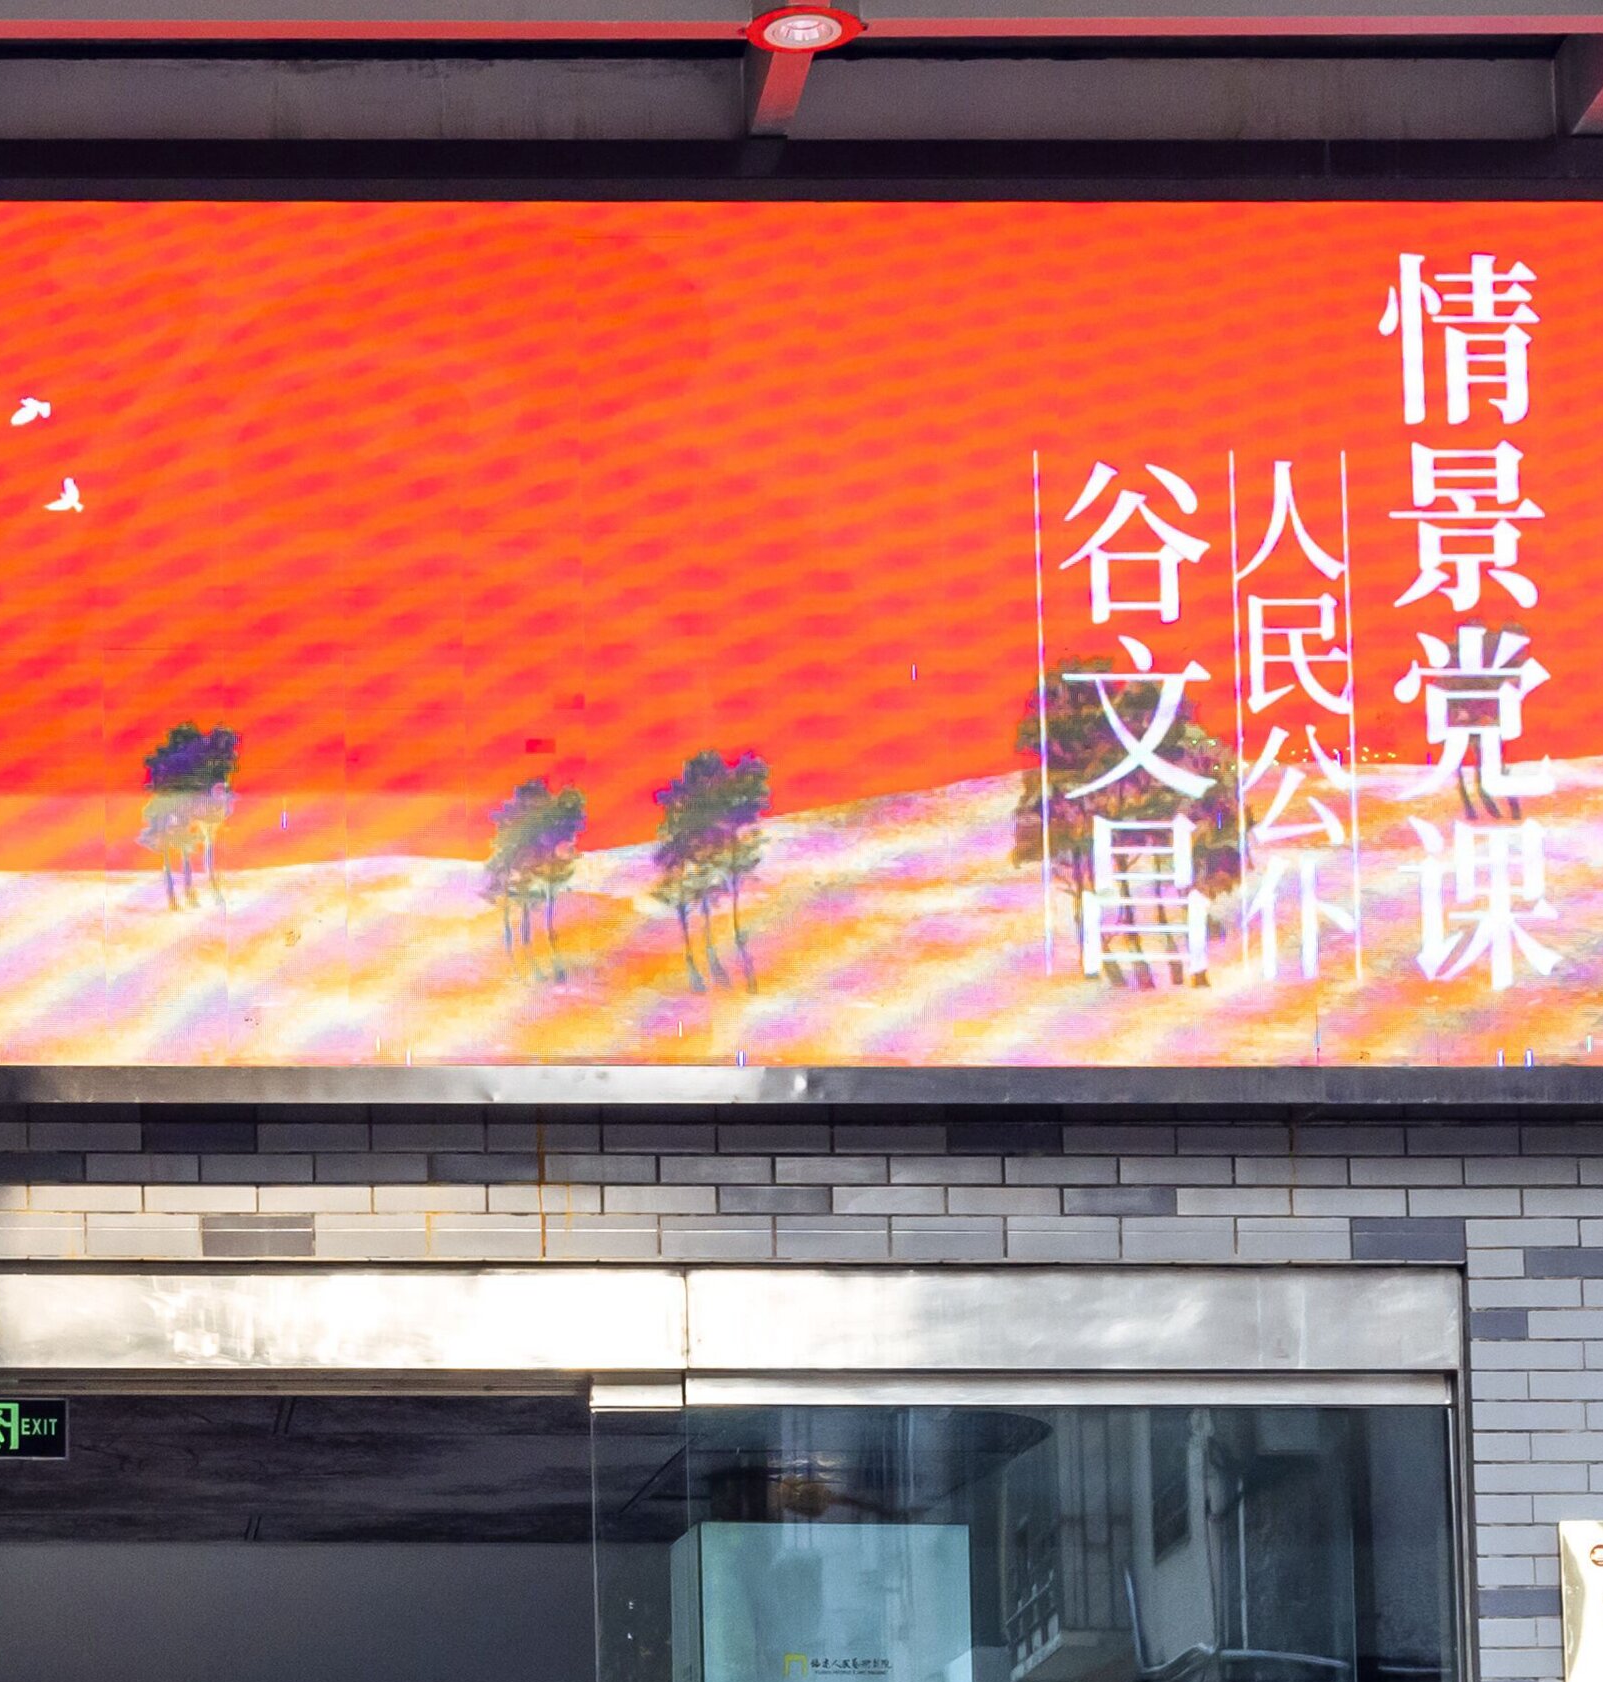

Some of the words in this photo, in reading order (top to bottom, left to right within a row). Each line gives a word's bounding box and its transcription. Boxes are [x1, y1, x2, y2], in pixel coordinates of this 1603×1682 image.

[1057, 458, 1214, 989] 谷文昌
[1234, 457, 1355, 975] 人民公仆
[1378, 250, 1564, 992] 情景党课
[21, 1418, 58, 1436] EXIT
